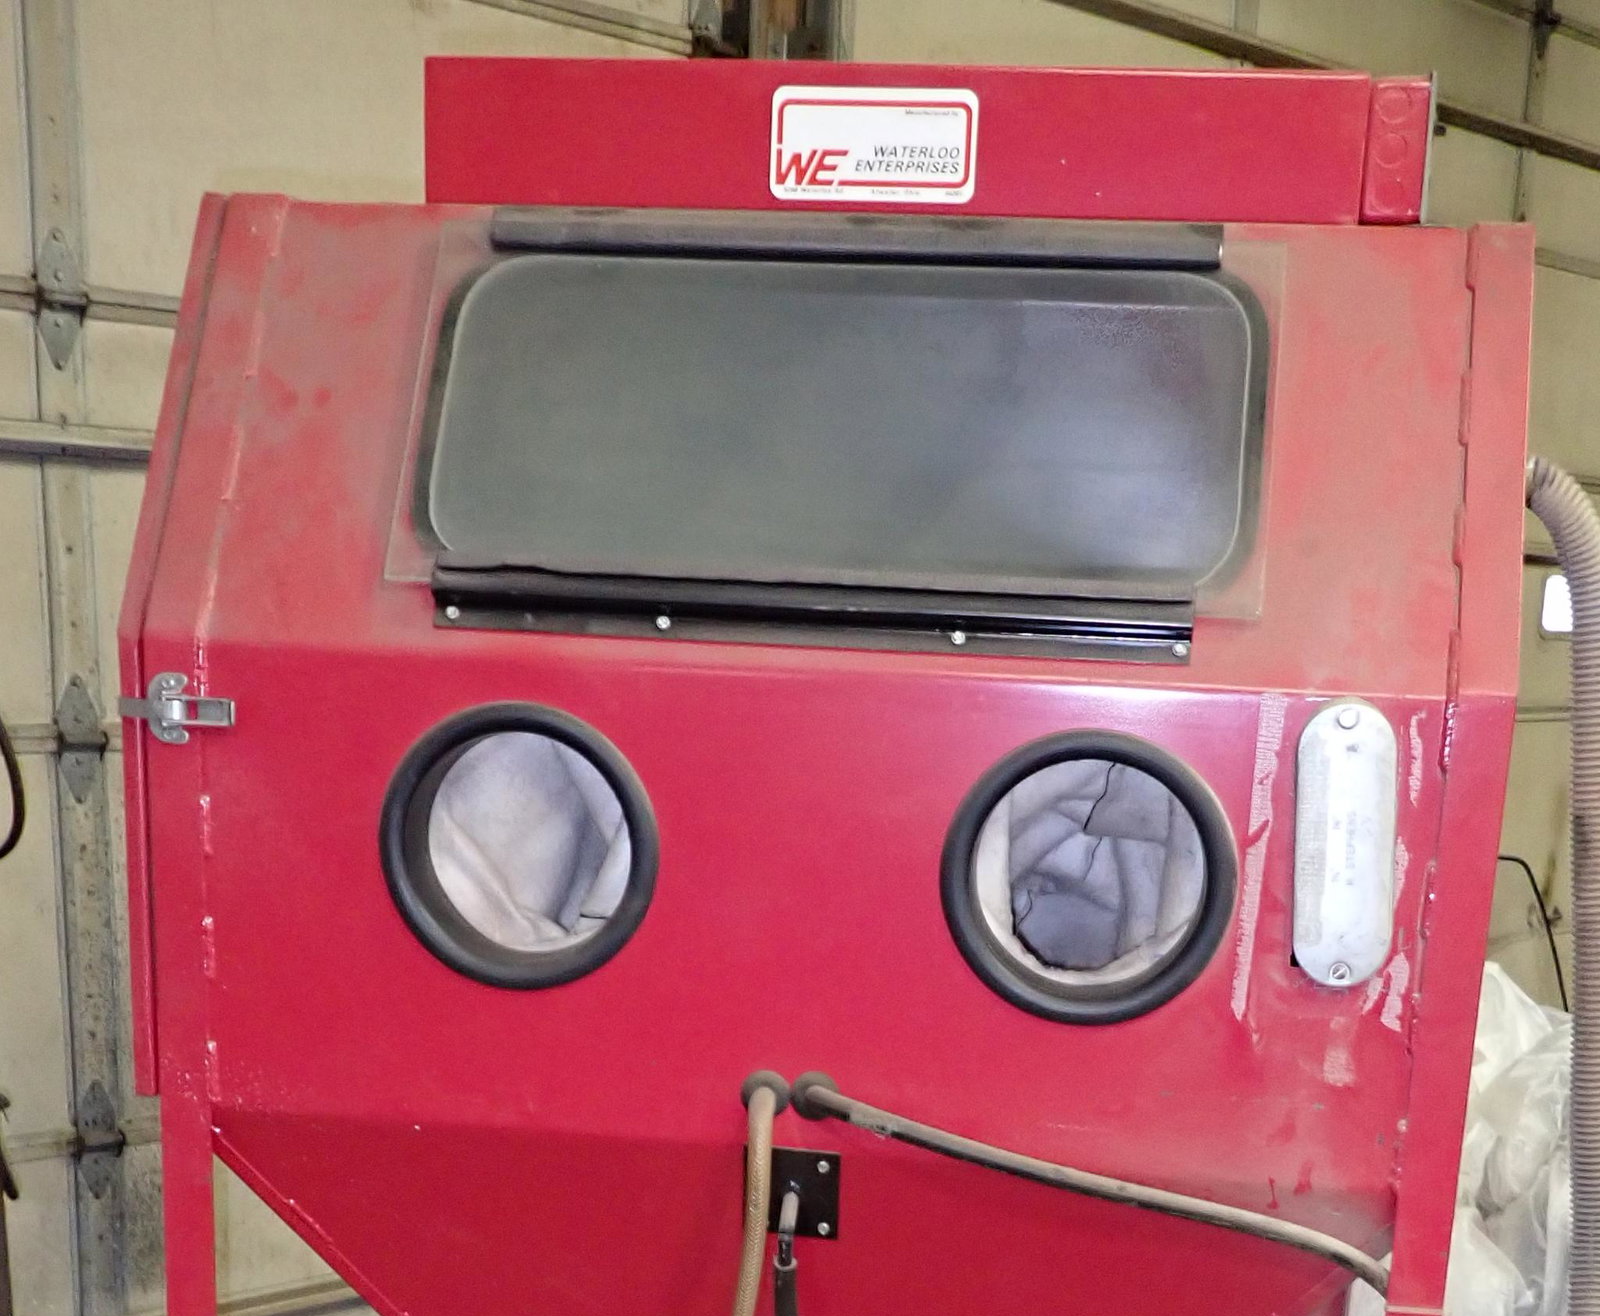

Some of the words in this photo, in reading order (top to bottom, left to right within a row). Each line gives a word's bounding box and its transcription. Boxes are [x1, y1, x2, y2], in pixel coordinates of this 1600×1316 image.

[873, 145, 961, 160] WATERLOO
[775, 147, 849, 187] WE
[854, 159, 960, 175] ENTERPRISES
